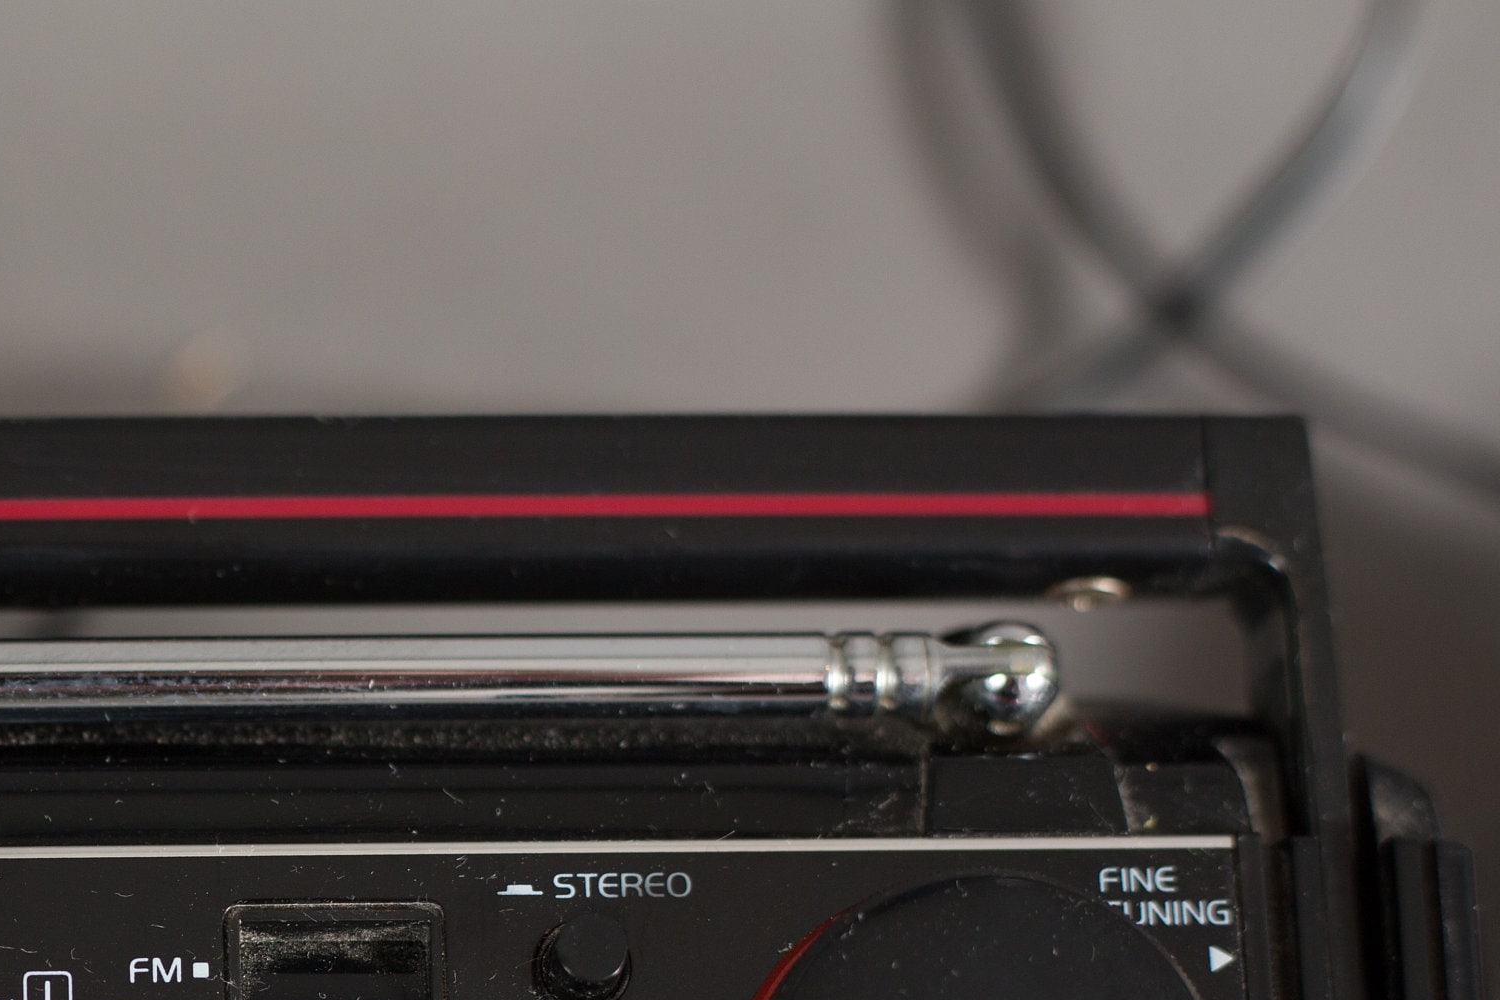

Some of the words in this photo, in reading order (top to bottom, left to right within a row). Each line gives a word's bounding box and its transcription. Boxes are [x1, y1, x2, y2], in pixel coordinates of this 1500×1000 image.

[553, 872, 692, 899] STEREO
[1099, 866, 1176, 893] FINE
[1107, 899, 1231, 926] UNING
[129, 956, 182, 984] FM
